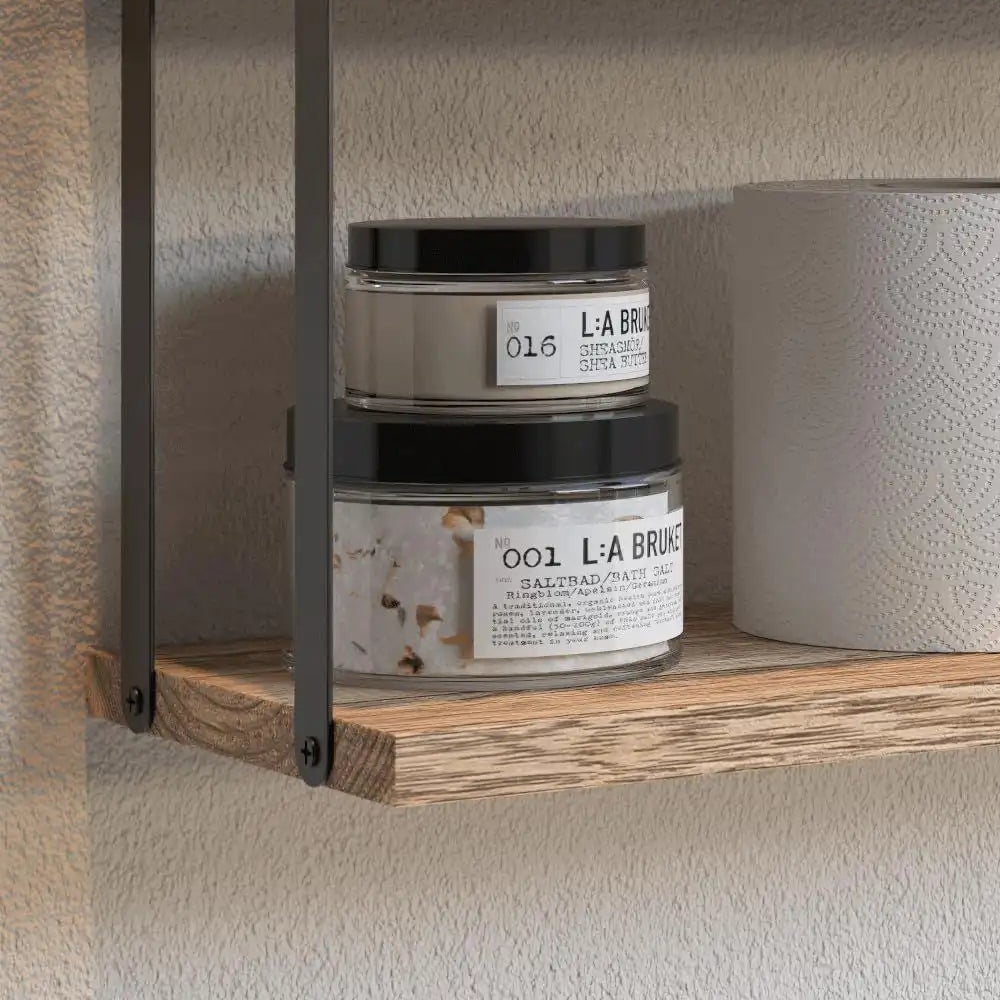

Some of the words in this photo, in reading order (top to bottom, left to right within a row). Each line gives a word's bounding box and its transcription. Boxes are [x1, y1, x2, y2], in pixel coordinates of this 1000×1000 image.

[582, 310, 614, 338] L:A
[506, 335, 557, 358] 016
[579, 356, 617, 372] SHEA
[502, 546, 562, 569] 001
[583, 534, 624, 565] L:A
[520, 568, 647, 590] SALTBAD/BATH
